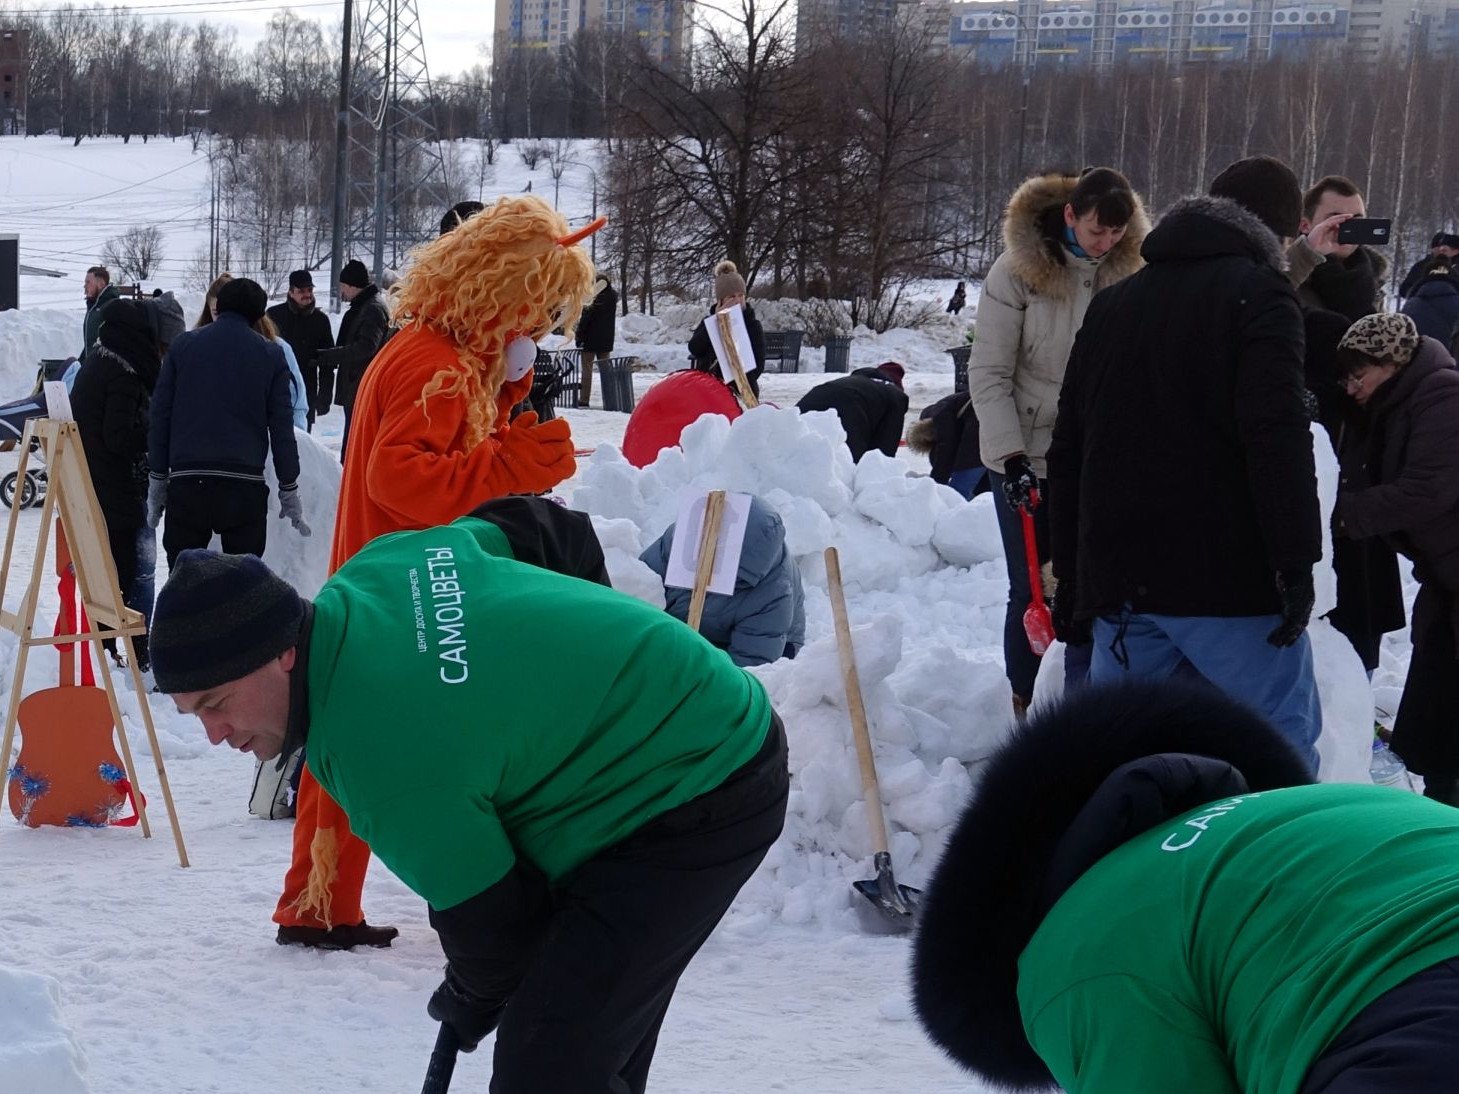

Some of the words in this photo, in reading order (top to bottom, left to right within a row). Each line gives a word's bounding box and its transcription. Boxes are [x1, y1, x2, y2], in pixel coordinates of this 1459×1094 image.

[409, 567, 422, 601] ТВОРЧЕСТВА
[414, 605, 426, 629] ДОСУГА
[425, 547, 469, 684] САМОЦВЕТЫ
[418, 630, 428, 653] ЦЕНТР
